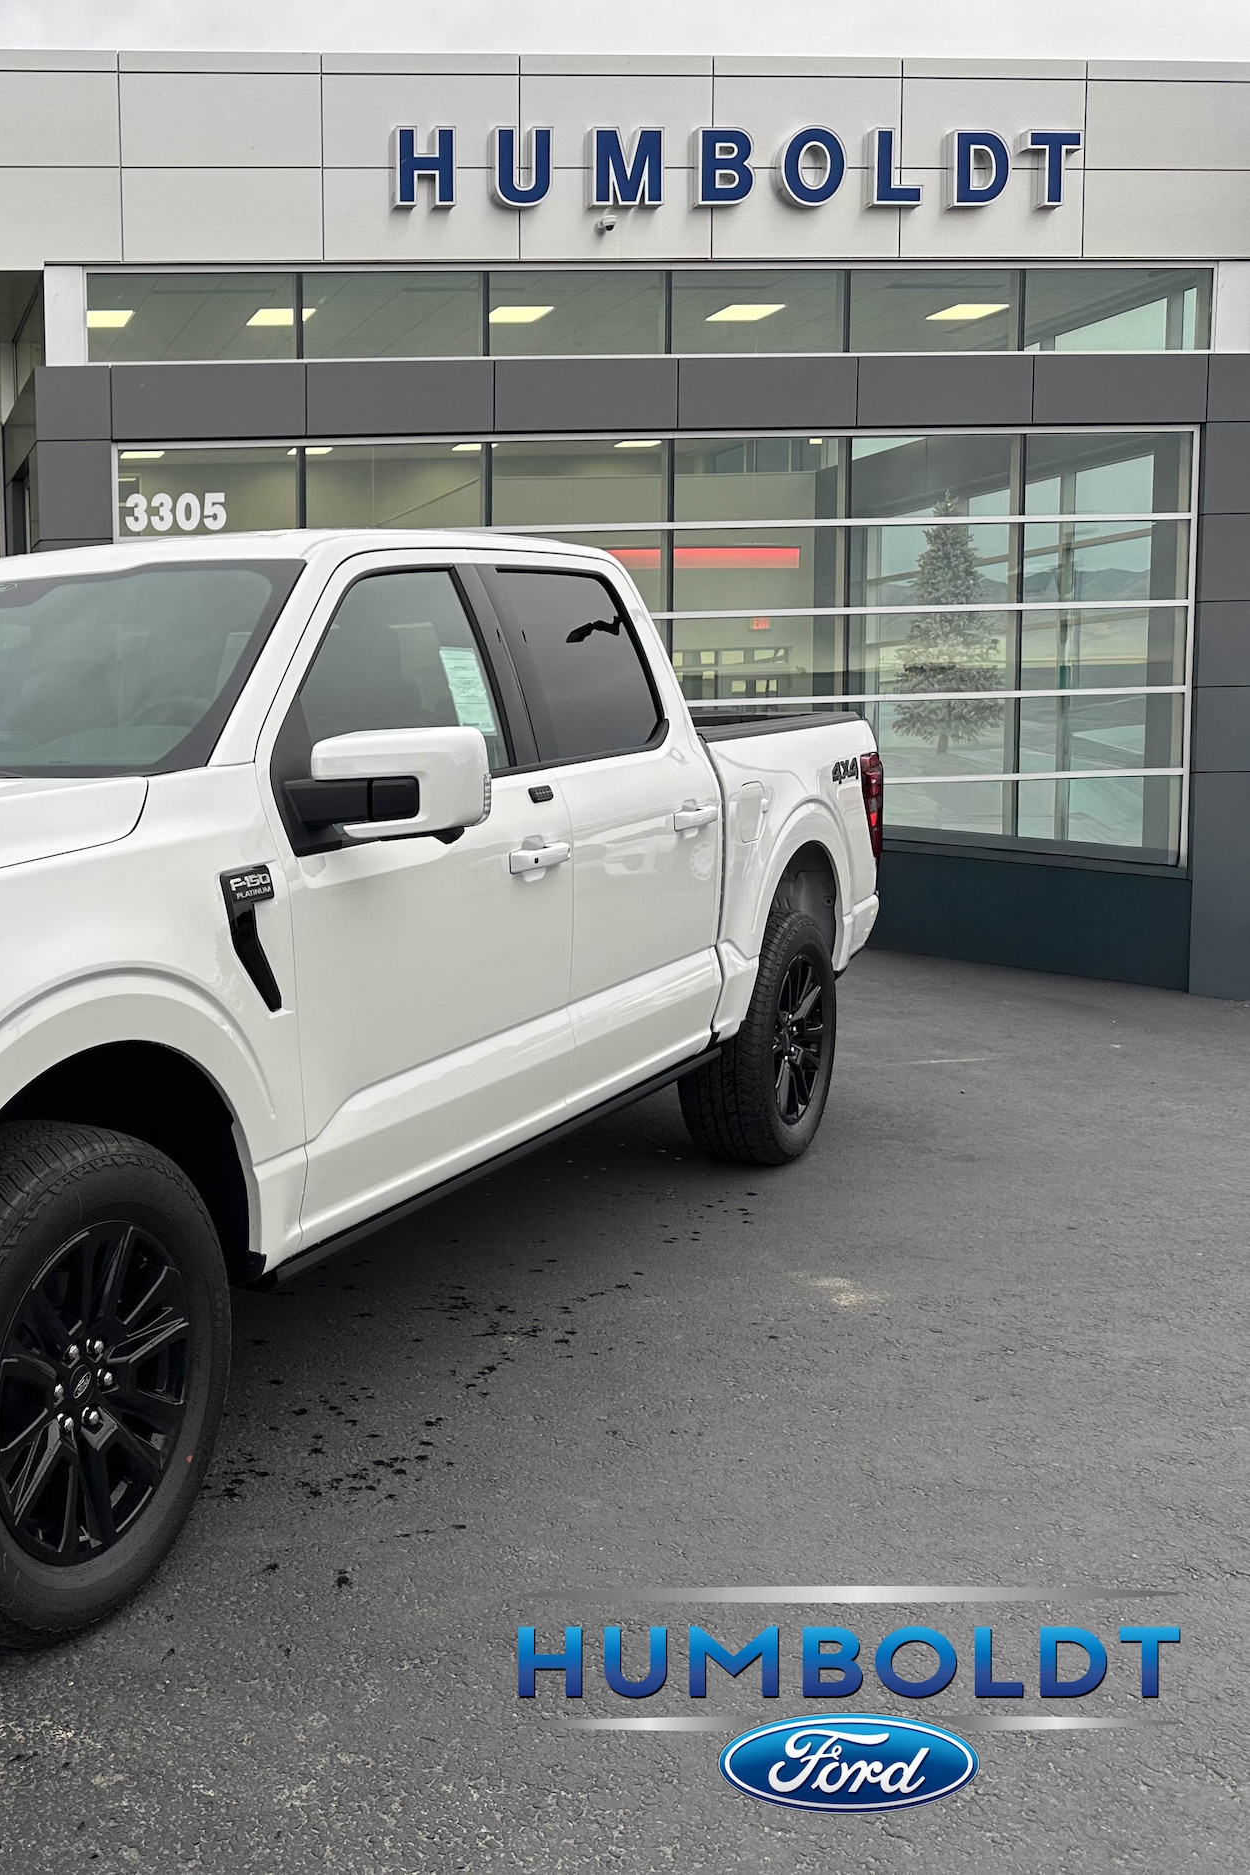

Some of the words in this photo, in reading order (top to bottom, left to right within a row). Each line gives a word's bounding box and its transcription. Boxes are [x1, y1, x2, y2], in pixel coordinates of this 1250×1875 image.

[392, 125, 1084, 209] HUMBOLDT
[125, 492, 227, 532] 3305
[230, 873, 271, 891] F-150
[236, 886, 272, 900] PLATINUM
